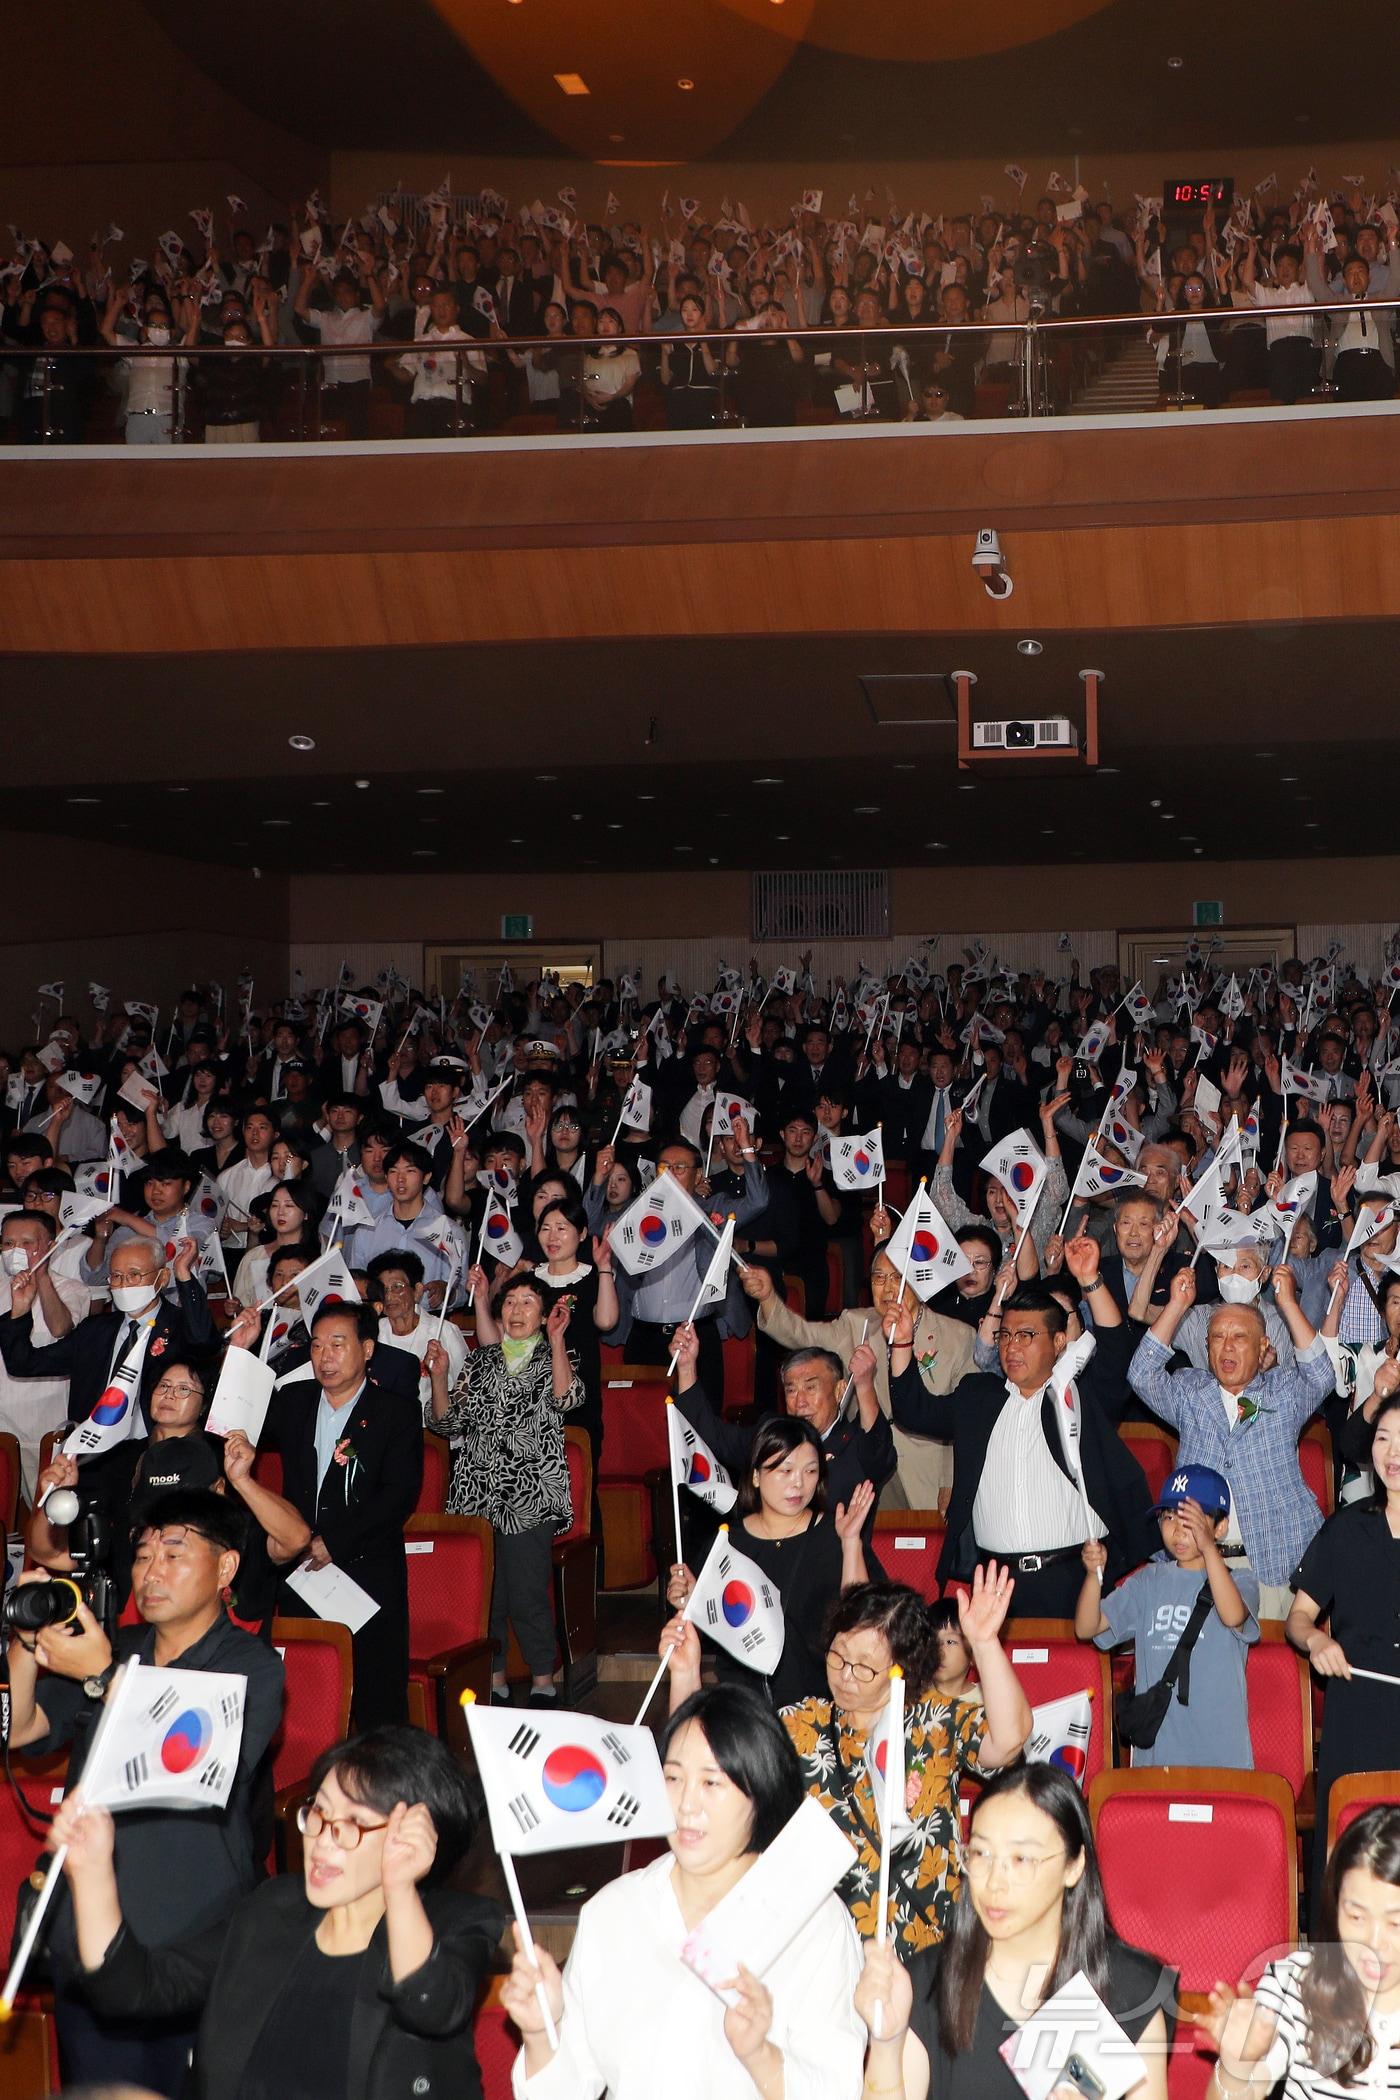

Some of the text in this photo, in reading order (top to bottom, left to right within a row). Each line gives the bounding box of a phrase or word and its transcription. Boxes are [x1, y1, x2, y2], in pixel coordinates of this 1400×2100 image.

[149, 1473, 180, 1484] mook
[1171, 1474, 1189, 1493] NY
[1, 1692, 10, 1742] SONY
